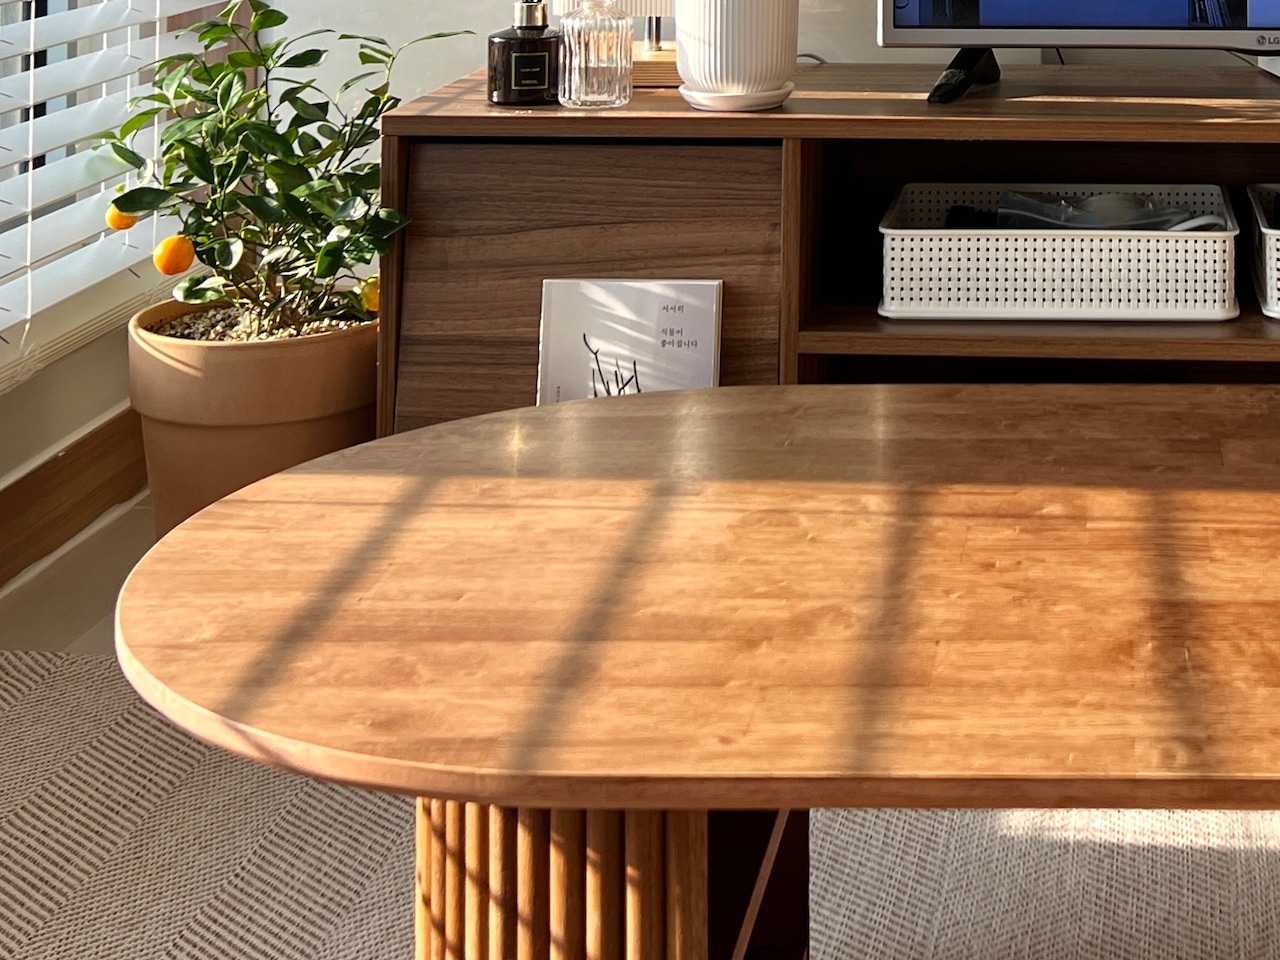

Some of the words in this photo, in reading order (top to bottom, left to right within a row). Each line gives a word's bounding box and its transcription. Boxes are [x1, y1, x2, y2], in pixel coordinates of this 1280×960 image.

[1268, 36, 1280, 45] LG
[662, 304, 684, 313] 서서히
[661, 328, 683, 336] 식물이
